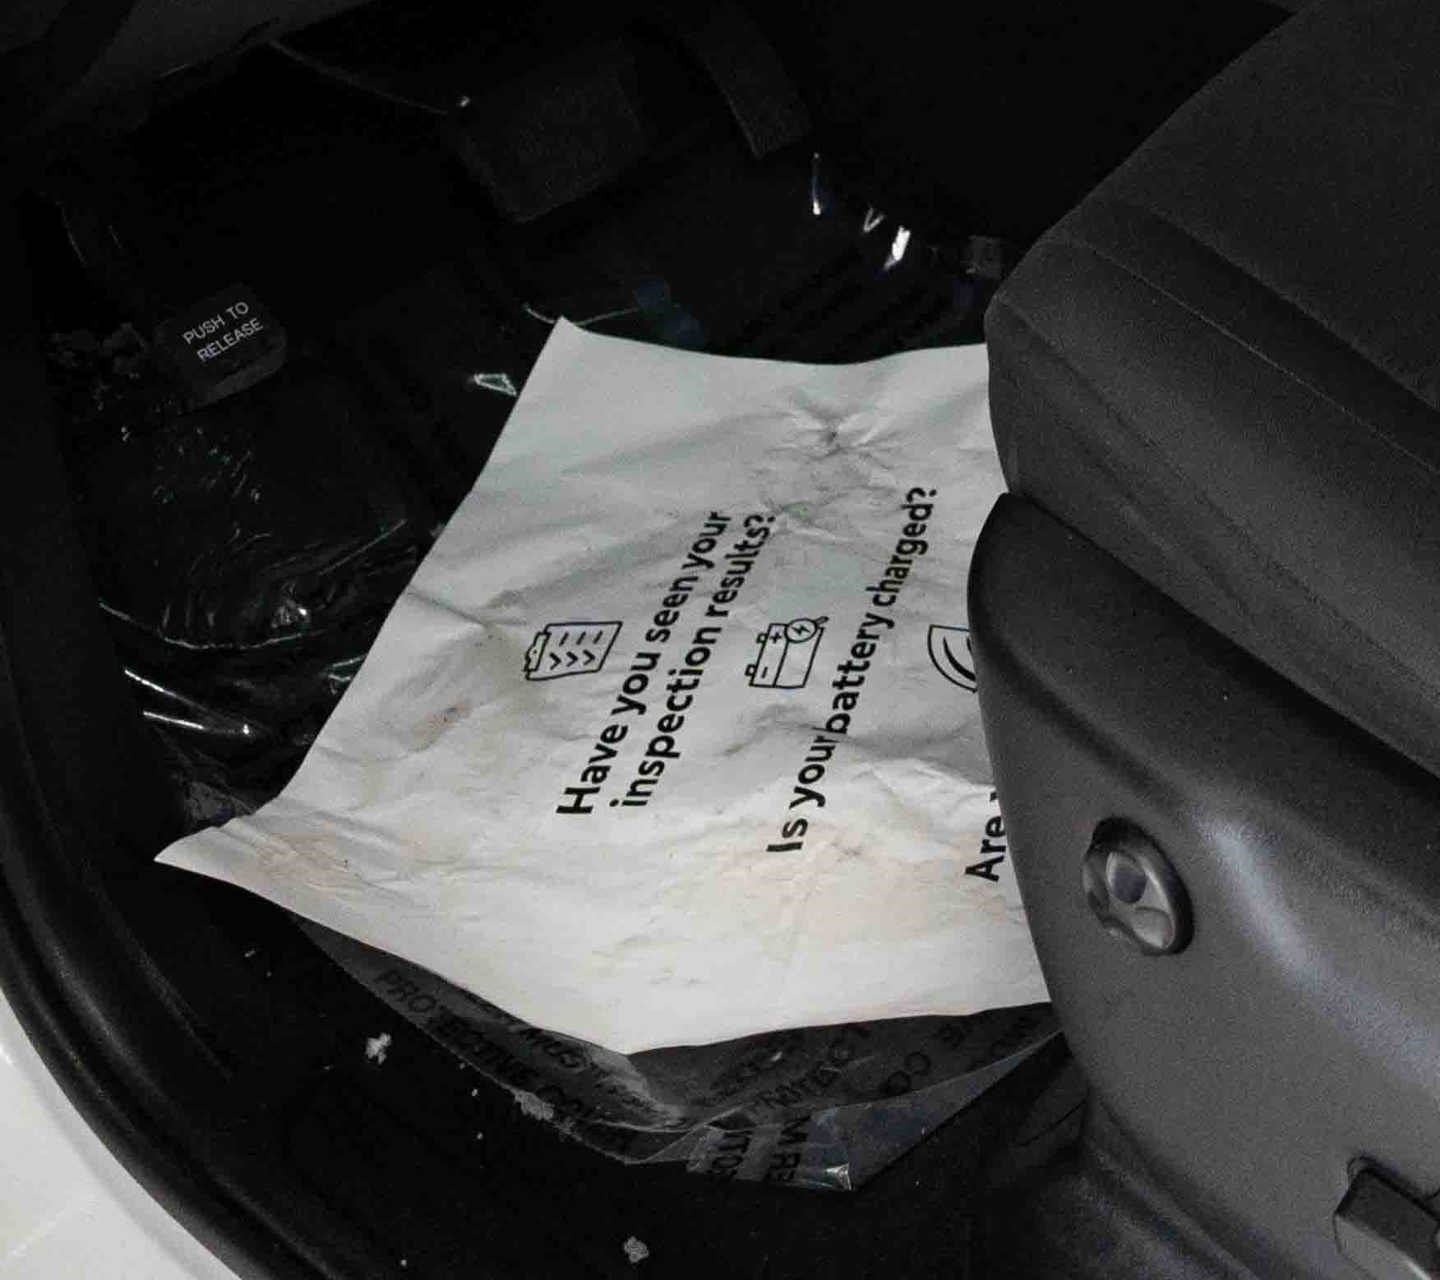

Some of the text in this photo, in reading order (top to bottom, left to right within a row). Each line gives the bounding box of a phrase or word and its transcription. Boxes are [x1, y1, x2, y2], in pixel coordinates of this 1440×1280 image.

[181, 301, 250, 345] PUSH TO
[196, 317, 265, 363] RELEASE
[555, 510, 732, 815] Have you seen your
[608, 513, 777, 808] inspection results?
[766, 486, 938, 853] Is your battery charged?
[964, 814, 1007, 883] Are
